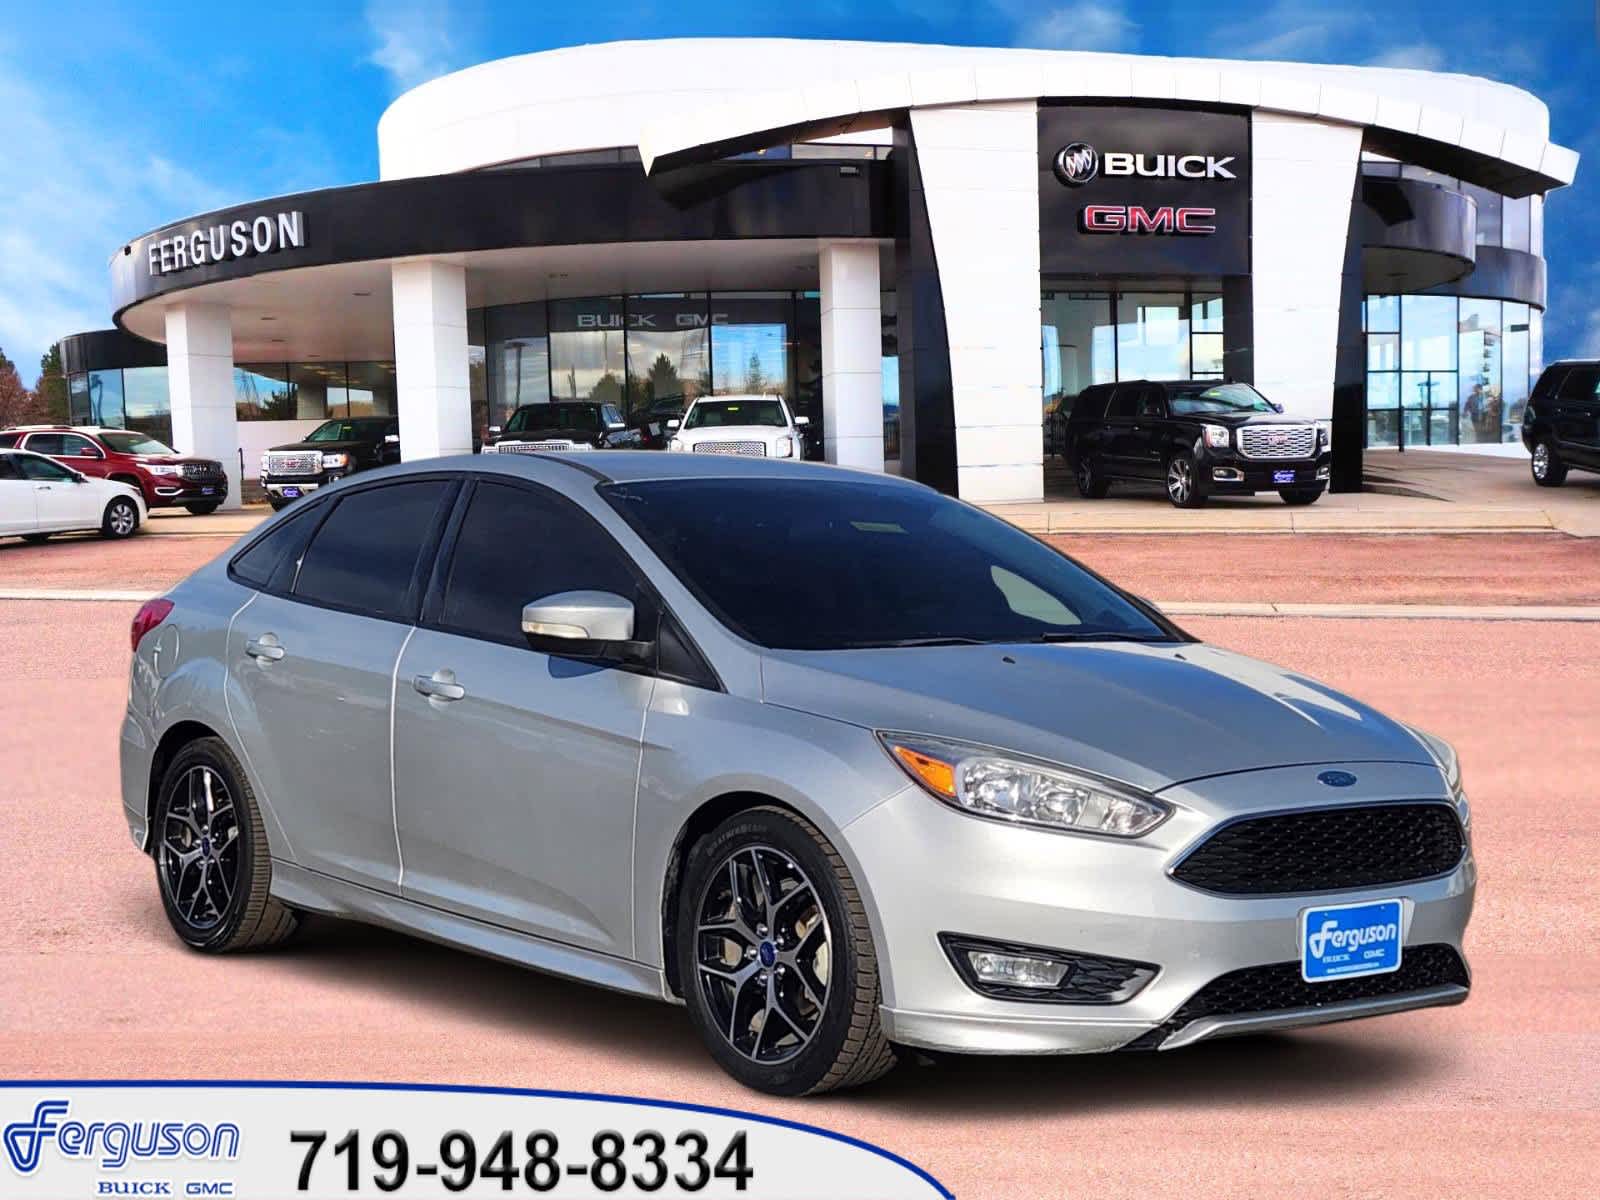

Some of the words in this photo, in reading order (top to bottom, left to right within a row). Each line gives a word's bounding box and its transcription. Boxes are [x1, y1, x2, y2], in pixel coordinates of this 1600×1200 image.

[1104, 153, 1237, 178] BUICK
[1085, 205, 1216, 233] GMC
[148, 211, 304, 276] FERGUSON
[577, 314, 656, 327] BUICK
[1308, 920, 1397, 959] Ferguson
